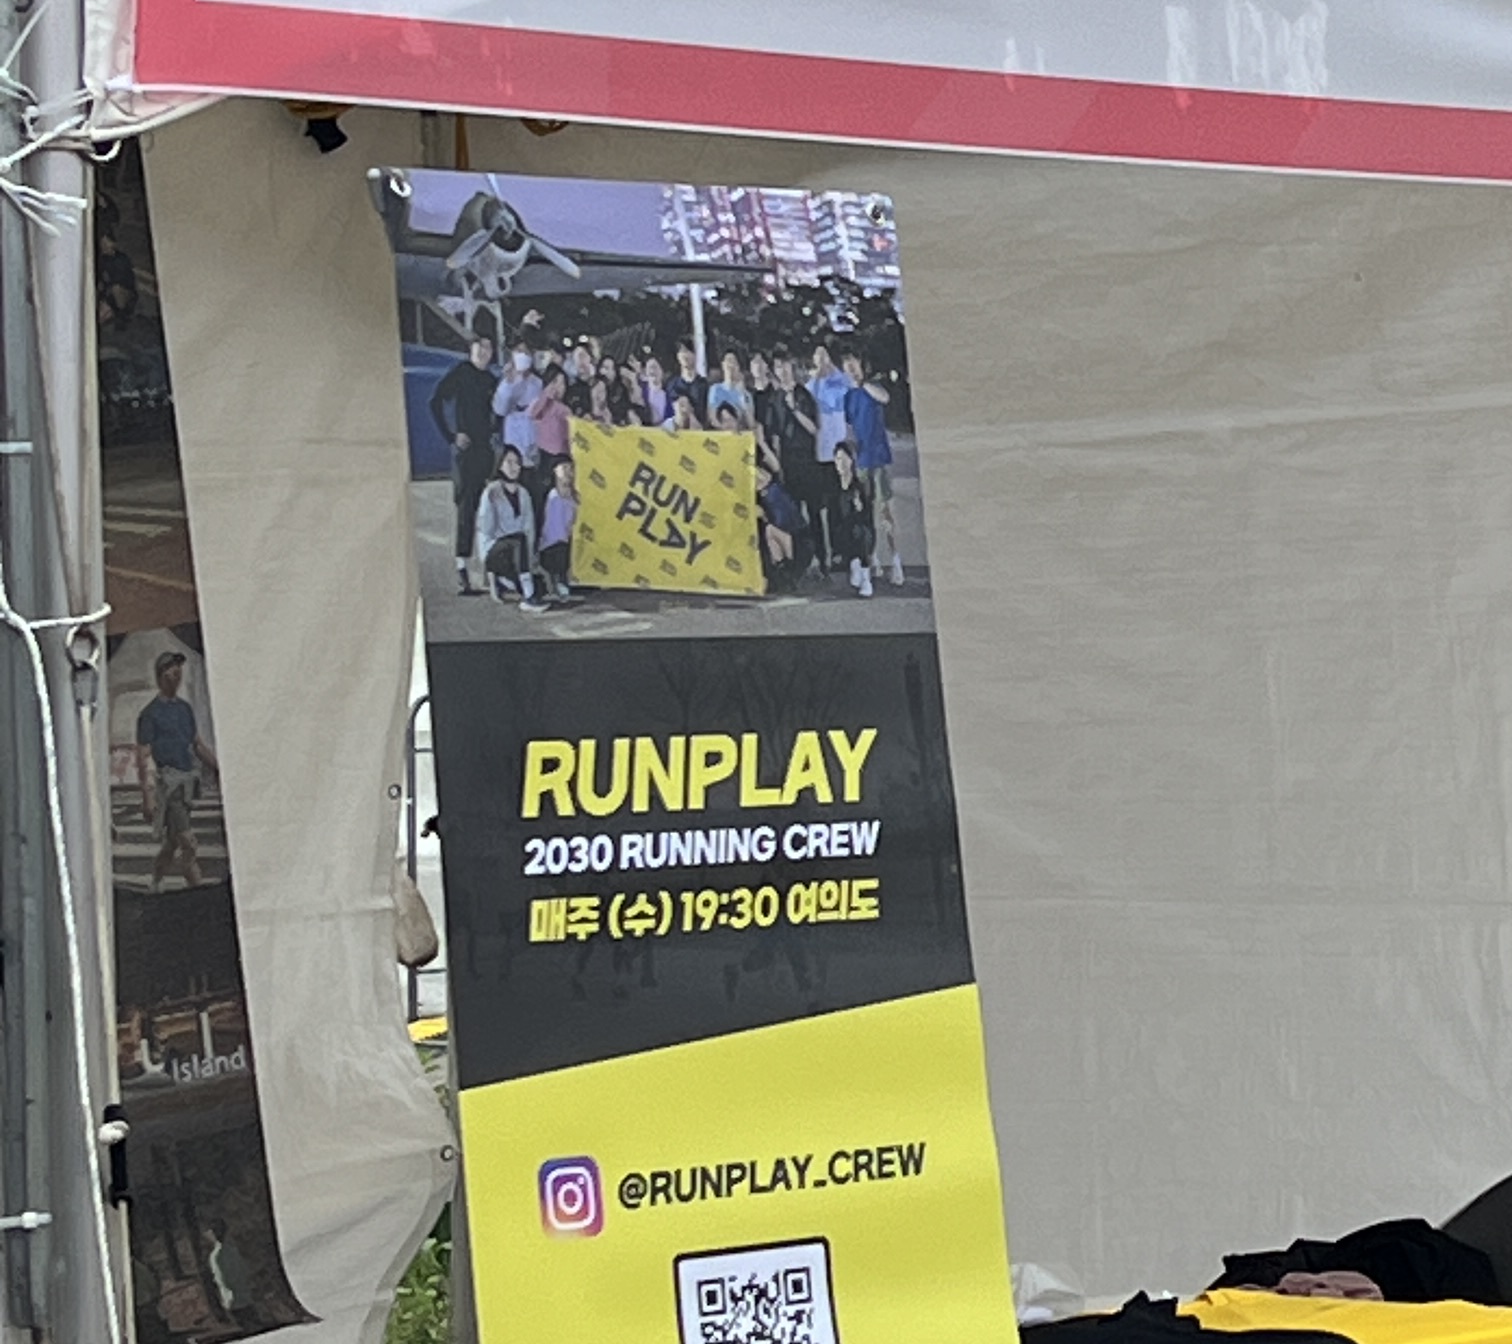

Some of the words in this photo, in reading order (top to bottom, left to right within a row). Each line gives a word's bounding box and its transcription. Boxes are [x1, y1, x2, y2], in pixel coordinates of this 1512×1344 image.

[628, 460, 701, 524] RUN
[615, 491, 712, 566] PLAY
[521, 728, 878, 818] RUNPLAY
[523, 833, 613, 876] 2030
[619, 825, 778, 870] RUNNING
[783, 819, 881, 861] CREW
[529, 896, 600, 943] 매주
[607, 890, 673, 939] (수)
[680, 885, 779, 932] 19:30
[786, 877, 880, 924] 여의도
[172, 1043, 247, 1084] Island
[617, 1142, 926, 1210] @RUNPLAY_CREW
